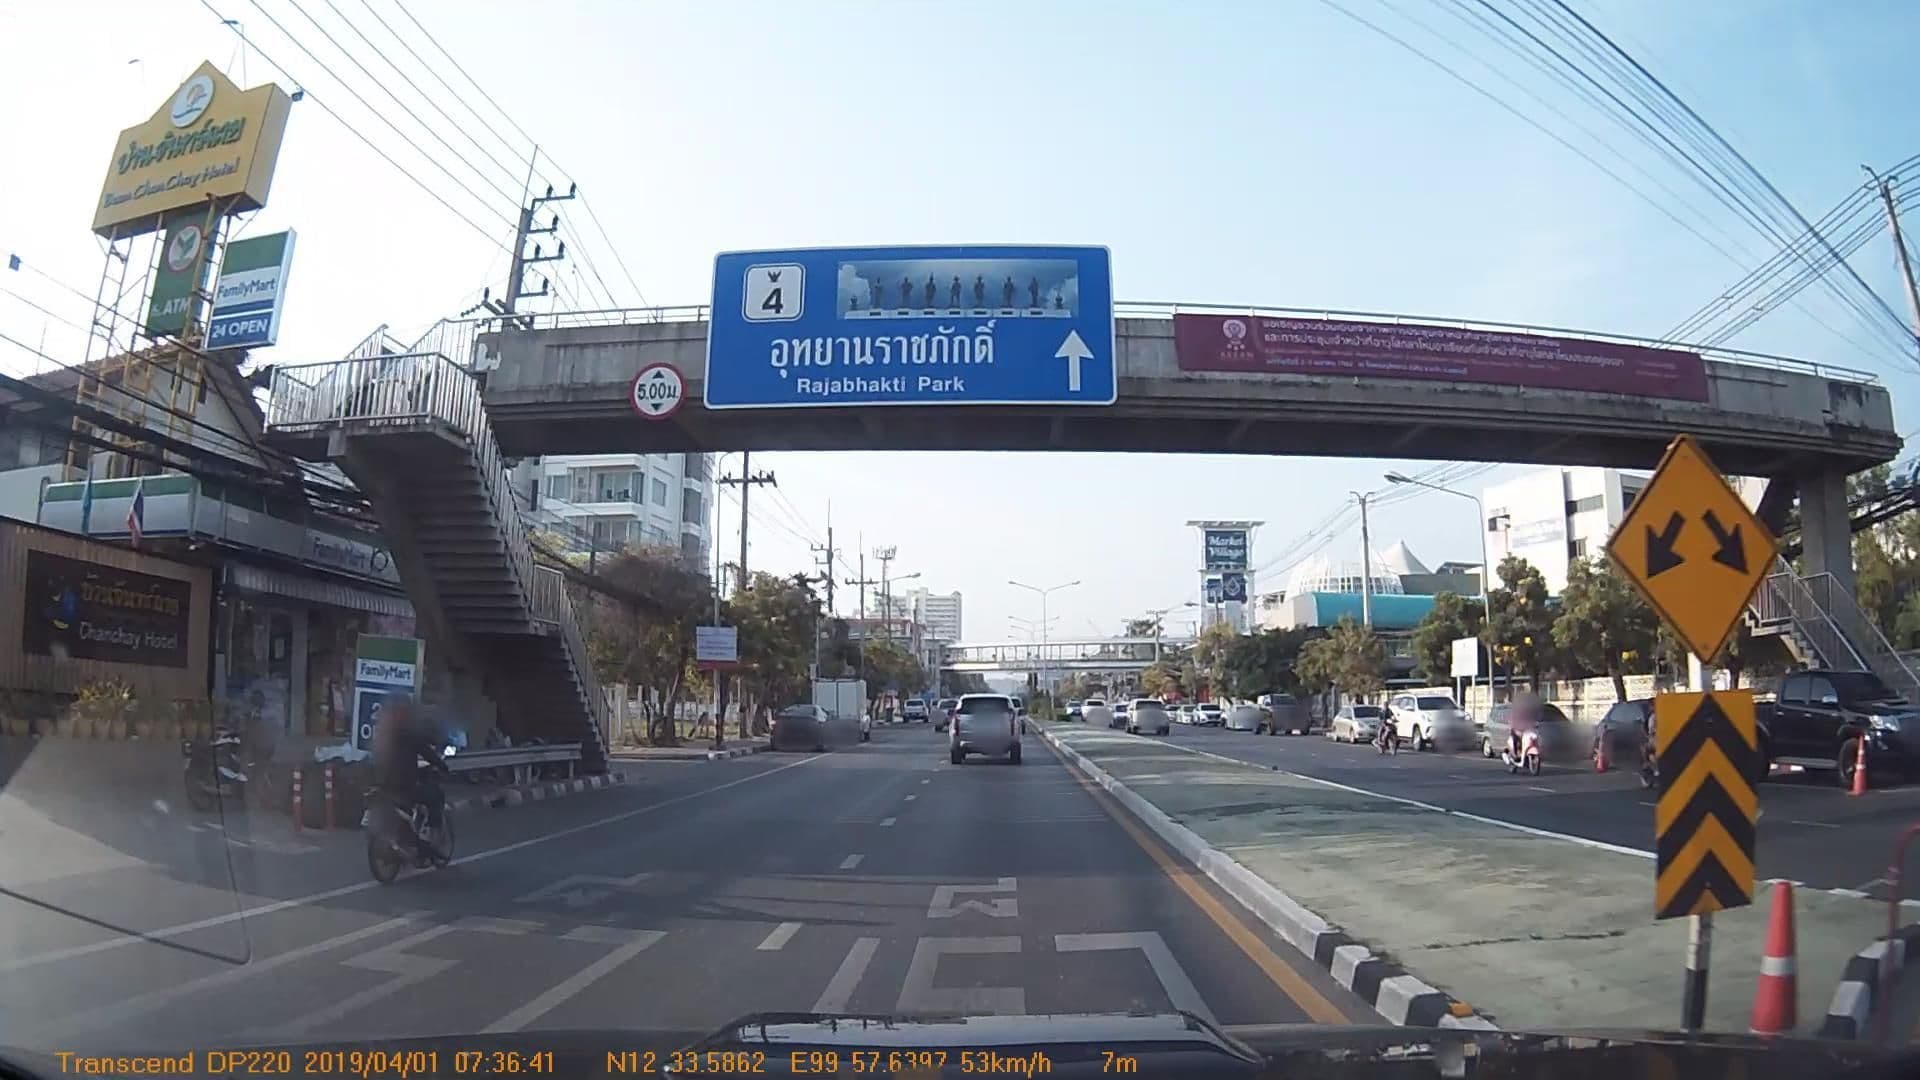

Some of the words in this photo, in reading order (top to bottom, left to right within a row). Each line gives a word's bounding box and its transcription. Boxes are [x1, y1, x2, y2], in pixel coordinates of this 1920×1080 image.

[133, 179, 167, 200] Chan
[166, 171, 200, 190] Chay
[201, 157, 240, 184] Hotel
[217, 277, 275, 299] FamilyMart
[761, 287, 784, 315] 4
[211, 325, 226, 338] 24
[228, 319, 268, 336] OPEN
[770, 319, 997, 379] อุทยานราชภักดิ์
[797, 378, 906, 395] Rajabhakti
[918, 376, 965, 392] Park
[1208, 536, 1244, 546] Market
[1208, 547, 1244, 560] Village
[79, 620, 141, 649] Chanchay
[144, 632, 178, 649] Hotel
[360, 663, 412, 680] FamilyMart
